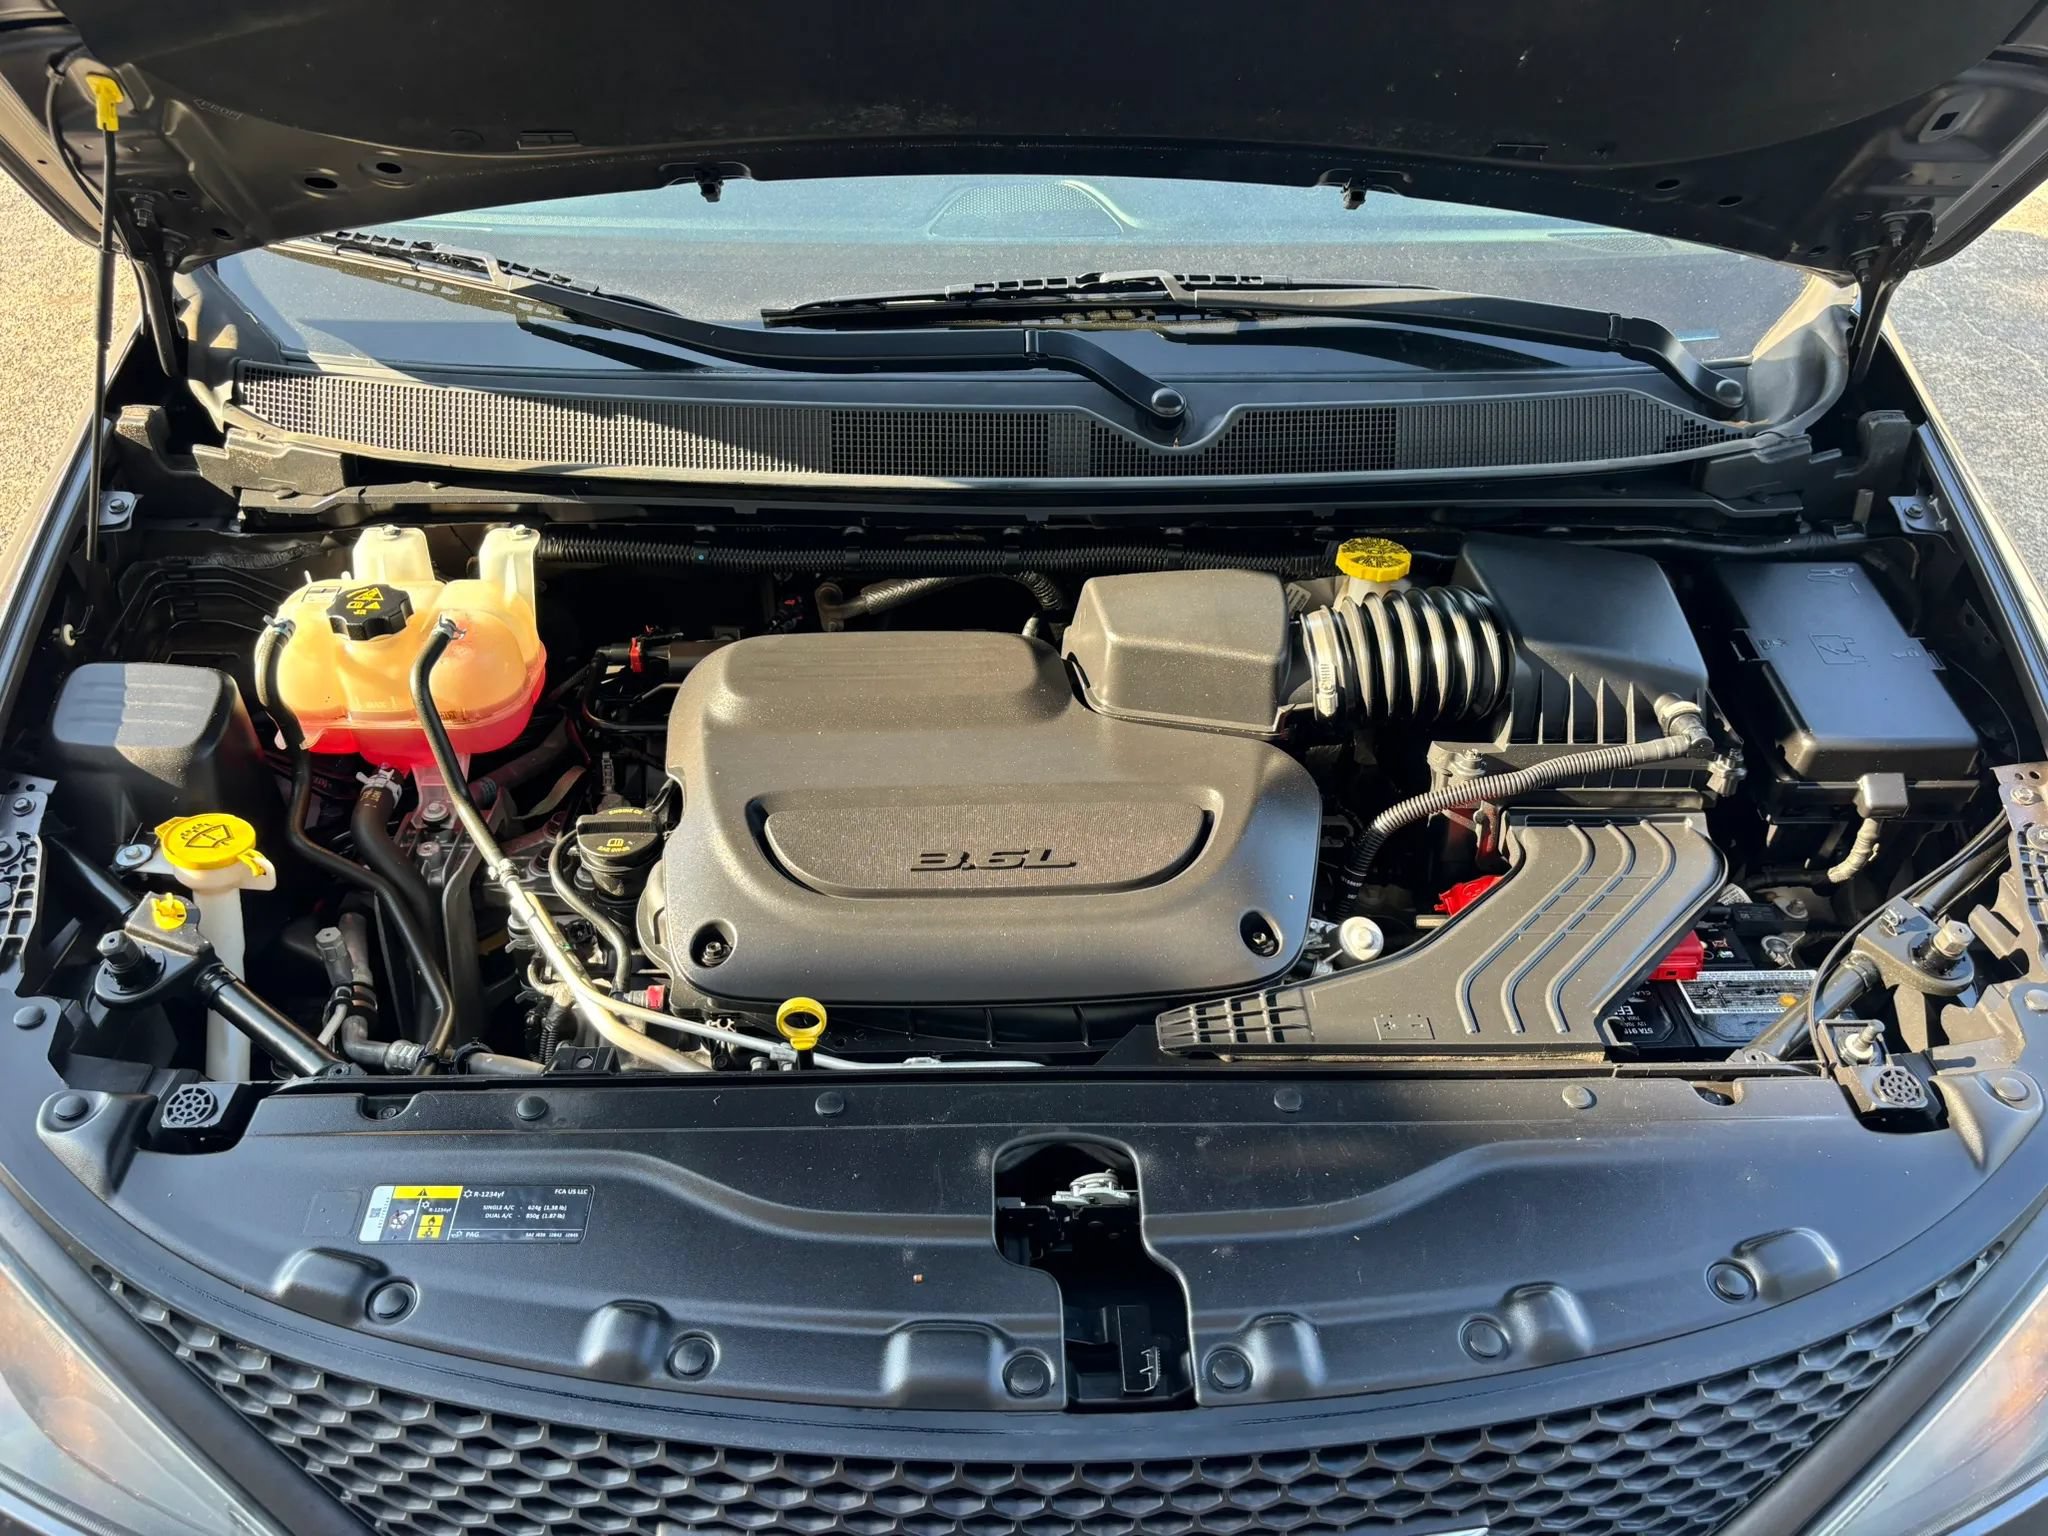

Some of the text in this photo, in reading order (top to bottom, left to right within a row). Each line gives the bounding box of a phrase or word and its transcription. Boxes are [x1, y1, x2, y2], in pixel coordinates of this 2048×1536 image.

[910, 849, 1077, 872] 3.6L
[1614, 1005, 1634, 1015] EF
[473, 1190, 505, 1200] R-1234yf
